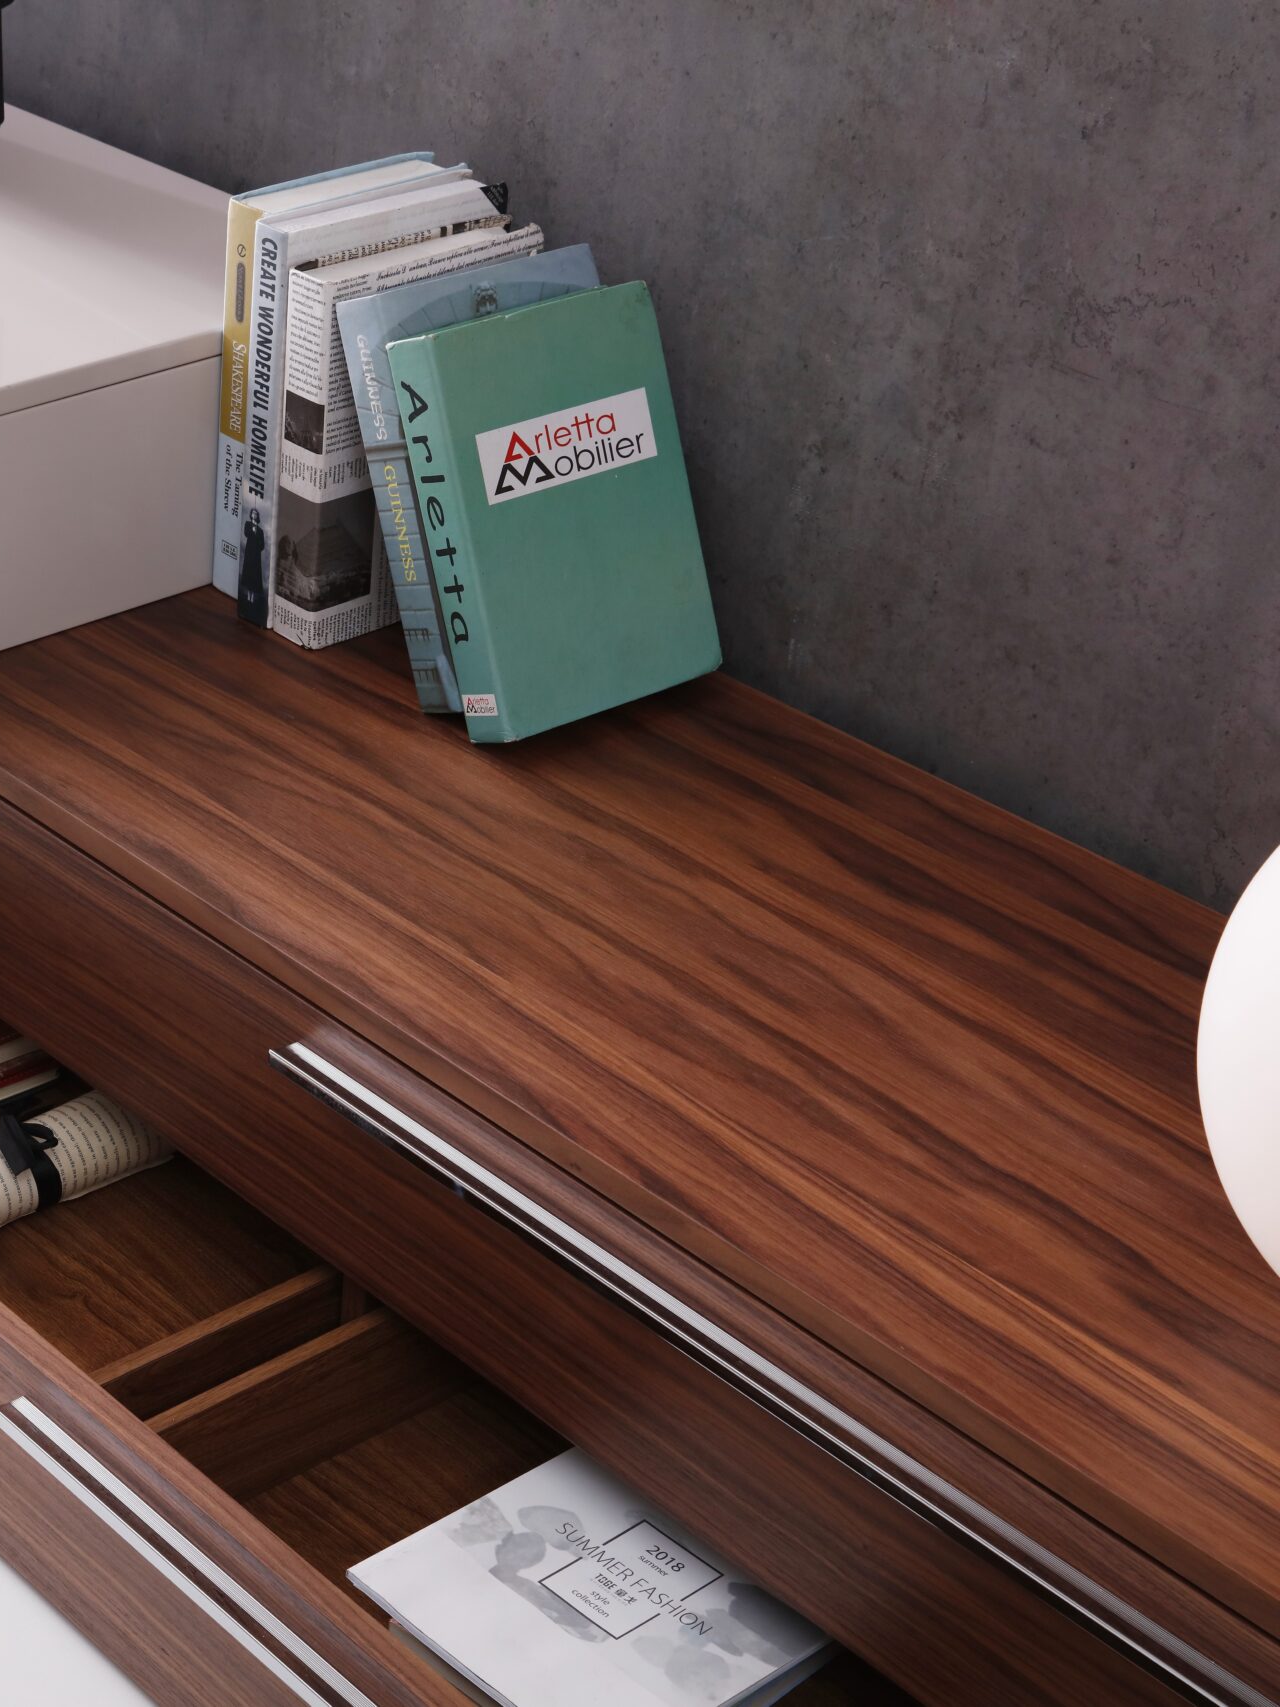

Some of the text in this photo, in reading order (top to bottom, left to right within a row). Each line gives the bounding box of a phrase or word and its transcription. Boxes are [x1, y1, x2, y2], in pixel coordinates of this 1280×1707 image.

[229, 341, 247, 434] SHAKESPEARE
[249, 237, 278, 500] CREATE WONDERFUL HOMELIFE
[357, 334, 388, 441] GUINNESS
[226, 444, 233, 459] of
[495, 432, 644, 496] Mobilier
[504, 413, 616, 463] Arletta
[223, 478, 232, 512] Shrew
[231, 452, 244, 518] The Taming
[400, 380, 469, 644] Arletta
[384, 464, 417, 584] GUINNESS
[555, 1522, 634, 1581] SUMMER
[630, 1578, 713, 1636] FASHION
[638, 1555, 668, 1577] summer
[646, 1545, 685, 1573] 2018
[571, 1589, 610, 1618] collection
[590, 1590, 610, 1606] style
